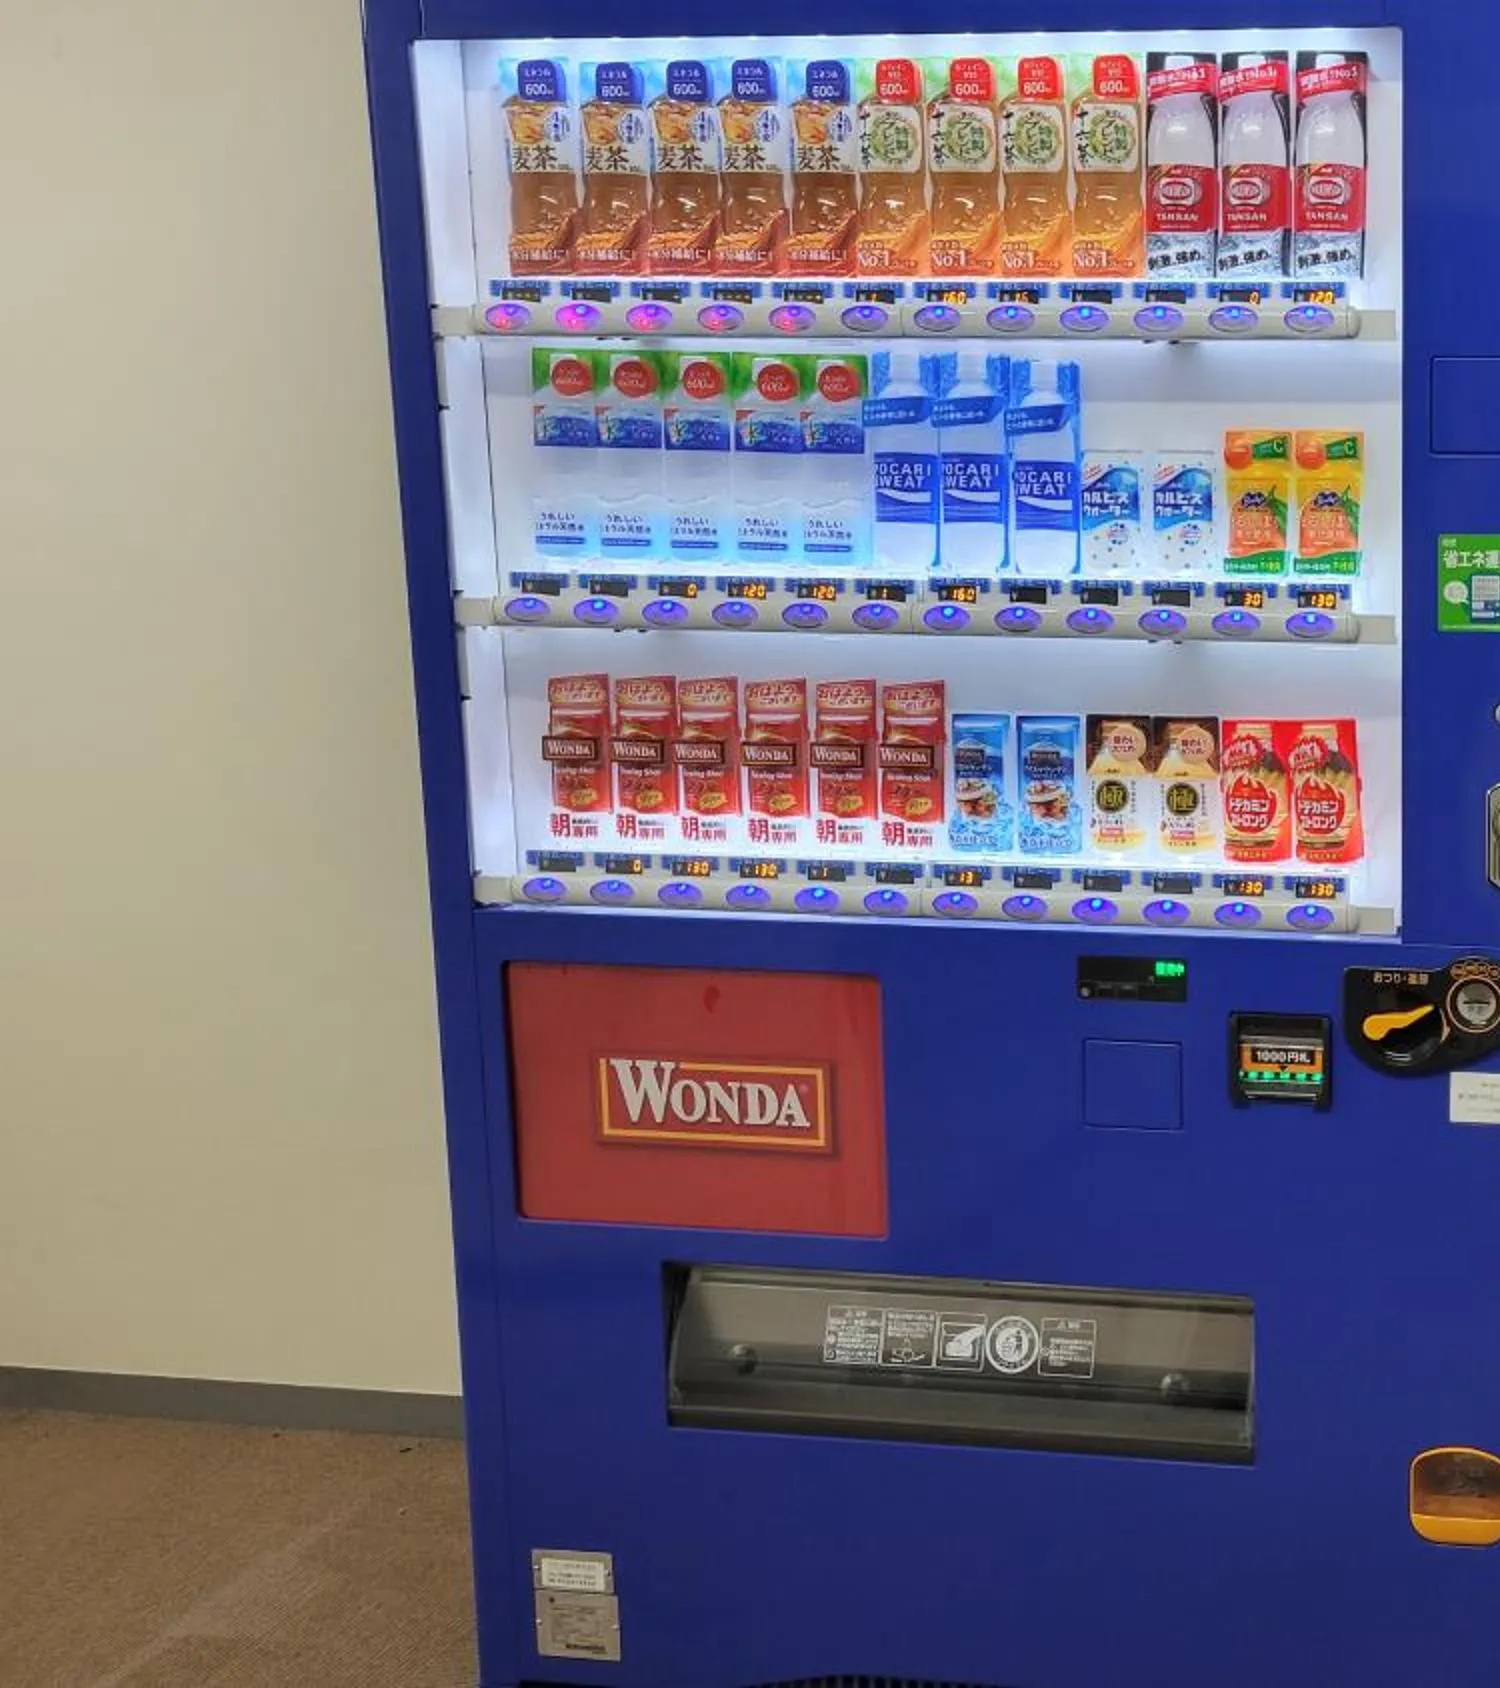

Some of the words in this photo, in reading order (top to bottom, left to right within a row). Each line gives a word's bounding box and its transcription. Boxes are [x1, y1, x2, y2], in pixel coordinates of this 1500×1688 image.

[875, 476, 925, 489] WEAT
[943, 475, 993, 488] WEAT
[1015, 483, 1067, 496] WEAT
[1256, 1049, 1311, 1063] 1000円札
[610, 1058, 811, 1128] WONDA
